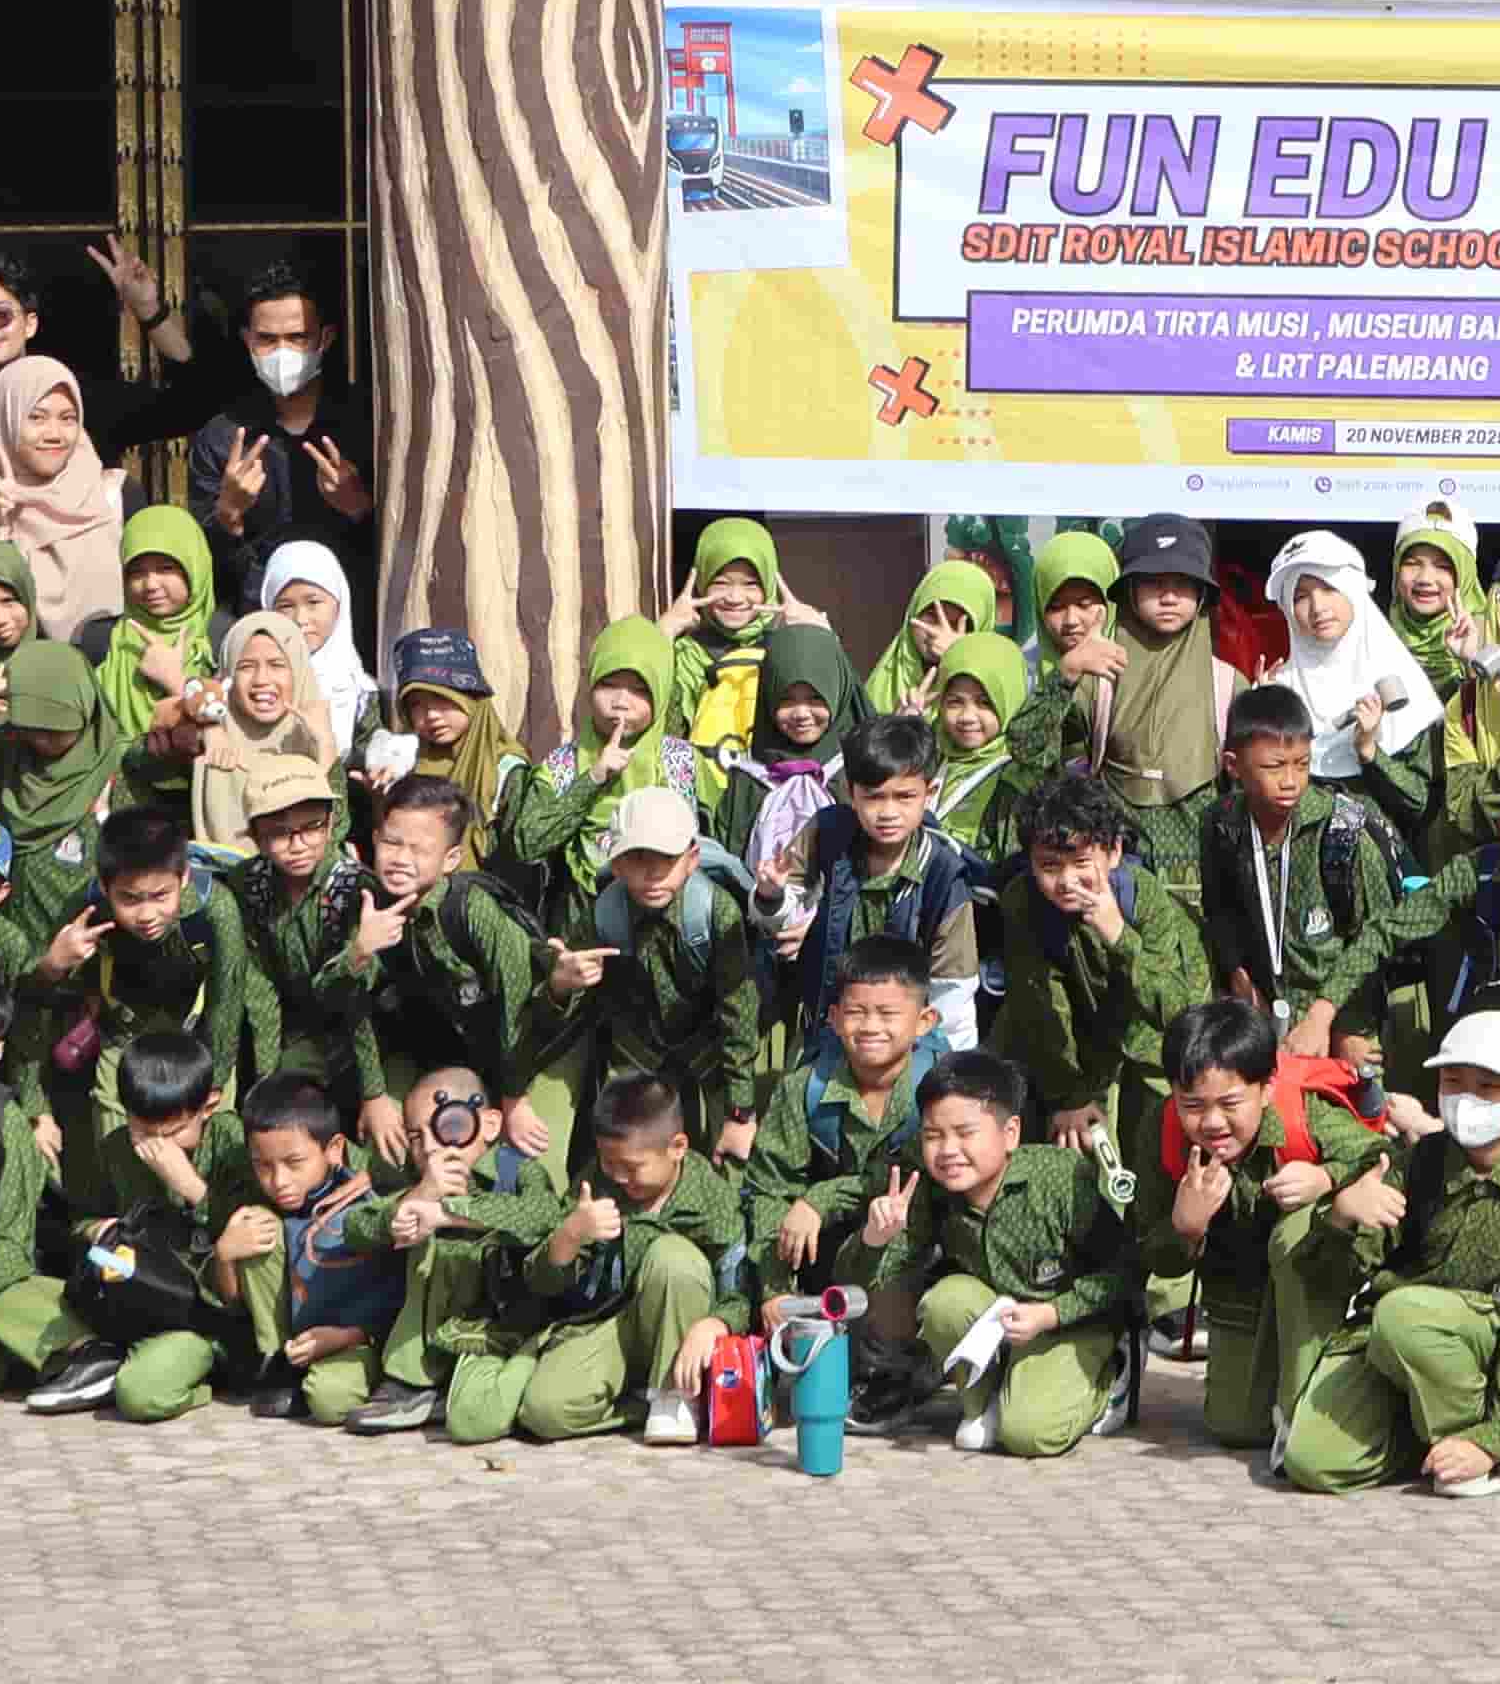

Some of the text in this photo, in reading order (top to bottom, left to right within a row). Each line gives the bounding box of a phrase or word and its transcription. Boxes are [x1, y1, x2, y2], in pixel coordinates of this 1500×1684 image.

[977, 112, 1222, 217] FUN
[1243, 115, 1488, 221] EDU
[962, 223, 1059, 264] SDIT
[1060, 224, 1195, 265] ROYAL
[1199, 226, 1370, 267] ISLAMIC
[1011, 307, 1146, 337] PERUMDA
[1154, 310, 1231, 337] TIRTA
[1327, 312, 1453, 340] MUSEUM
[1235, 352, 1490, 382] & LRT PALEMBANG
[1267, 424, 1323, 444] KAMIS
[1346, 427, 1367, 444] 20
[1370, 428, 1462, 446] NOVEMBER
